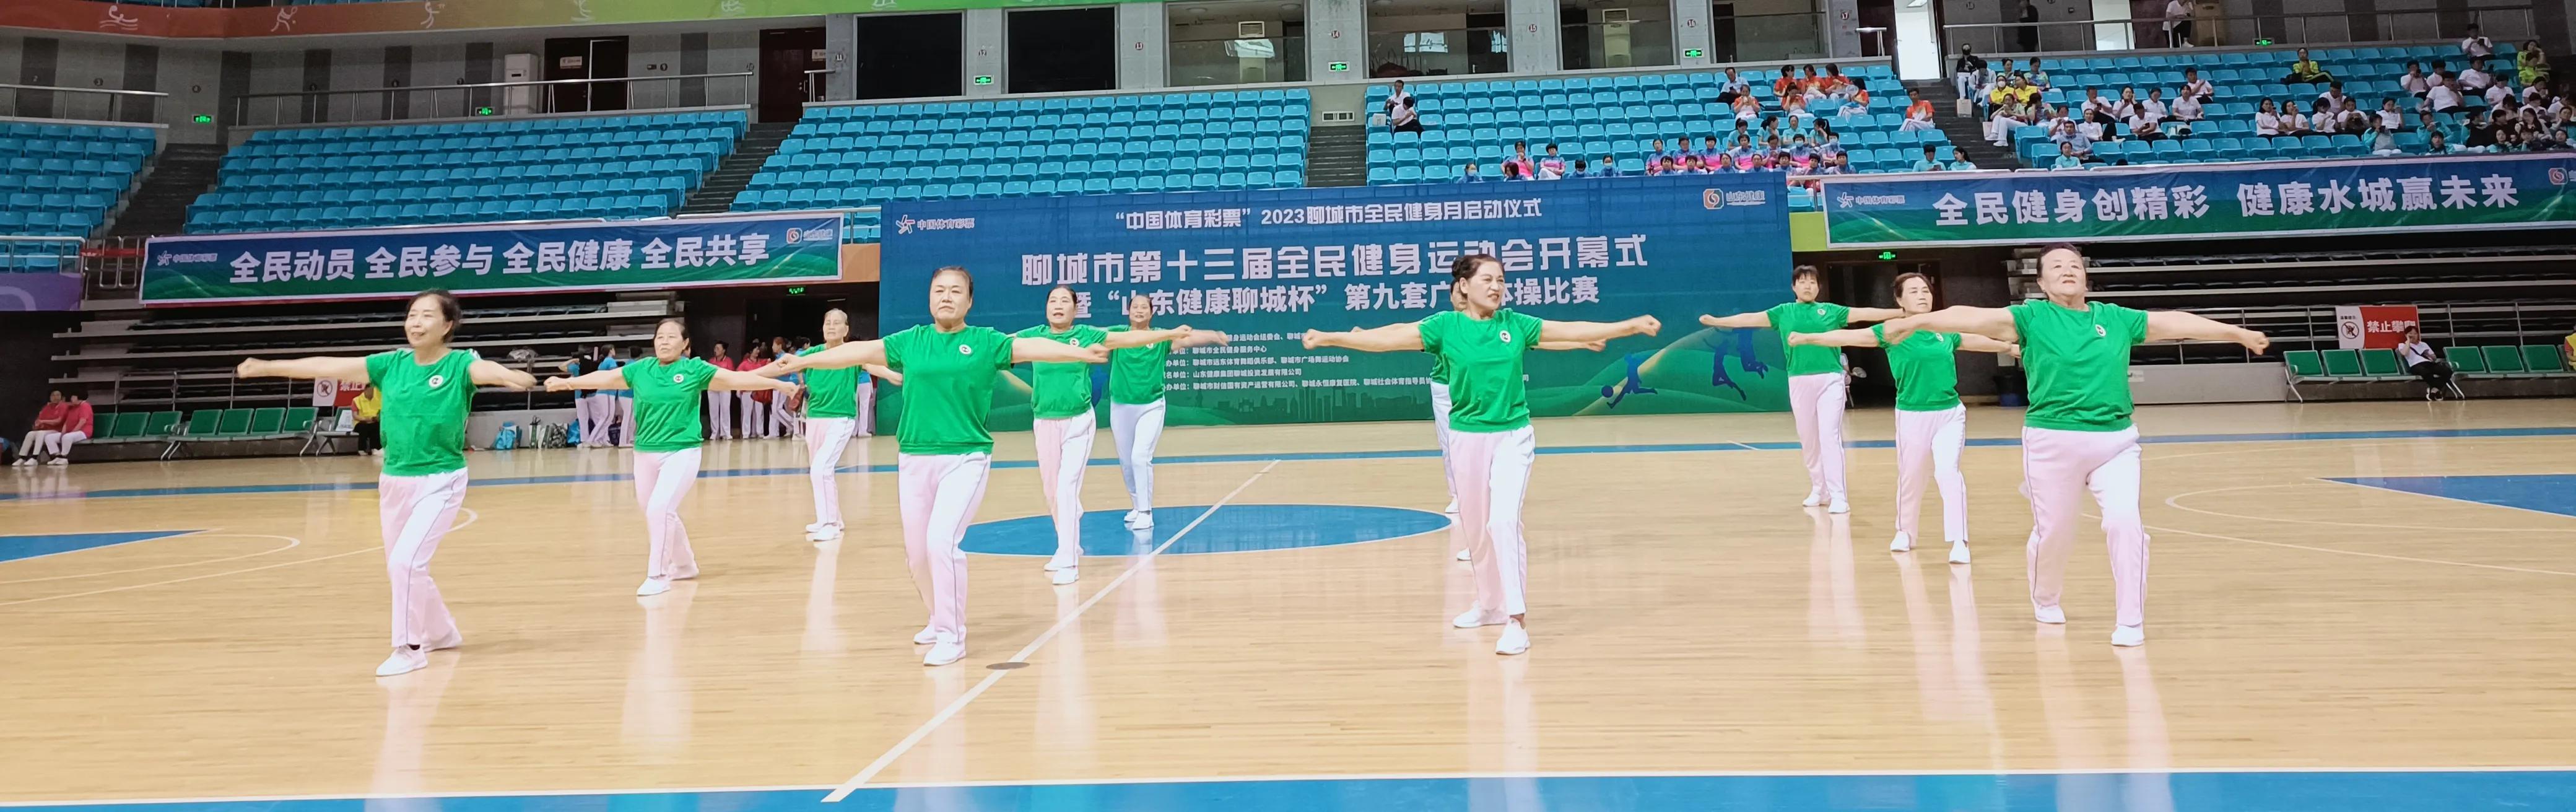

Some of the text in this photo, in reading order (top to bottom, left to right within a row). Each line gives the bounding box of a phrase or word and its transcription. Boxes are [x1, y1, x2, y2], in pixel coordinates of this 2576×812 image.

[1933, 174, 2519, 227] 全民健身创精彩 健康水城赢未来
[230, 232, 770, 283] 全民动员 全民参与 全民健康 全民共享
[1168, 345, 1268, 356] 单位：聊城市全民健身服务中心
